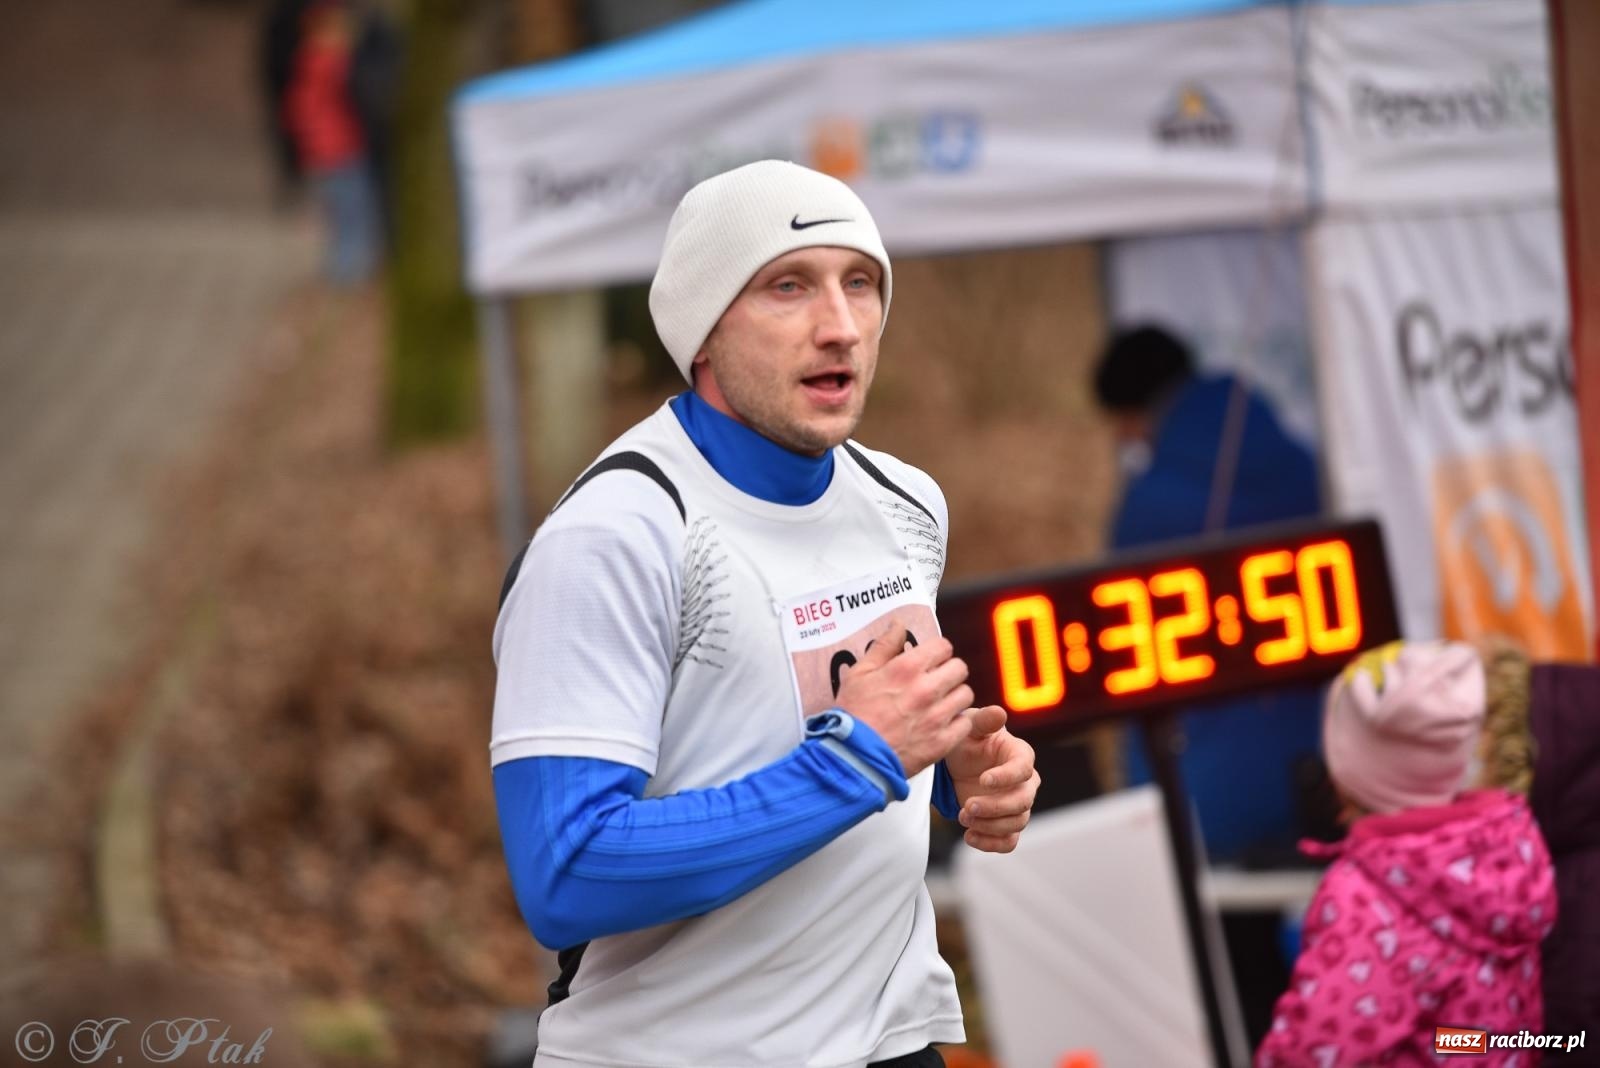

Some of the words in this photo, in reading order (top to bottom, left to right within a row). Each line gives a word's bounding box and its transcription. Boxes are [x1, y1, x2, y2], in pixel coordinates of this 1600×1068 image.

[793, 599, 833, 626] BIEG
[835, 575, 912, 612] Twardziela
[993, 539, 1363, 712] 0:32:50
